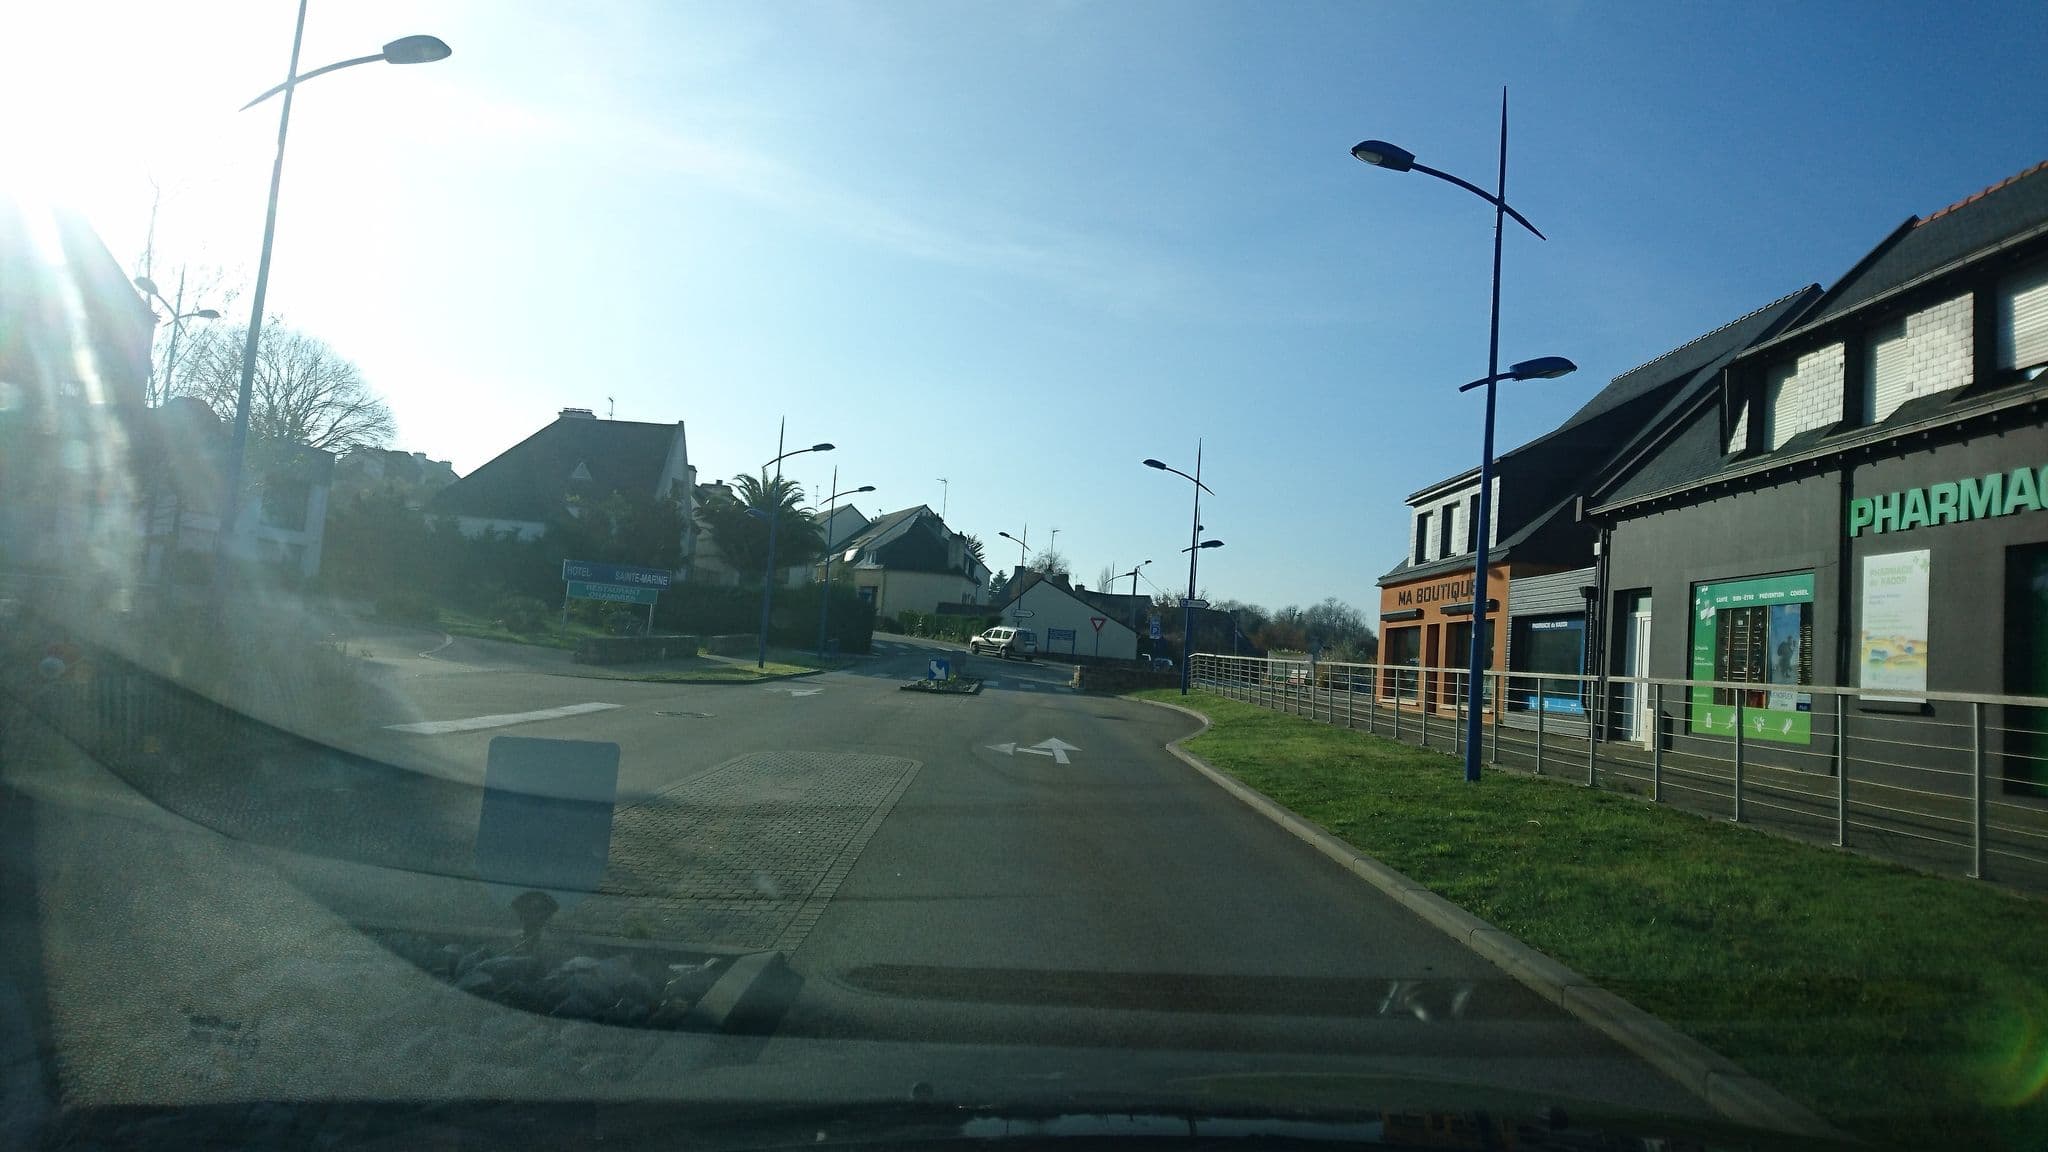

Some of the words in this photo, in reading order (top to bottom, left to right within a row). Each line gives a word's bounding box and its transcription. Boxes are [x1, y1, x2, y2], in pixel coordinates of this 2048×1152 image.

[615, 570, 669, 586] SAINTE-MARINE
[1398, 590, 1412, 606] MA
[1790, 589, 1809, 597] CONSEIL
